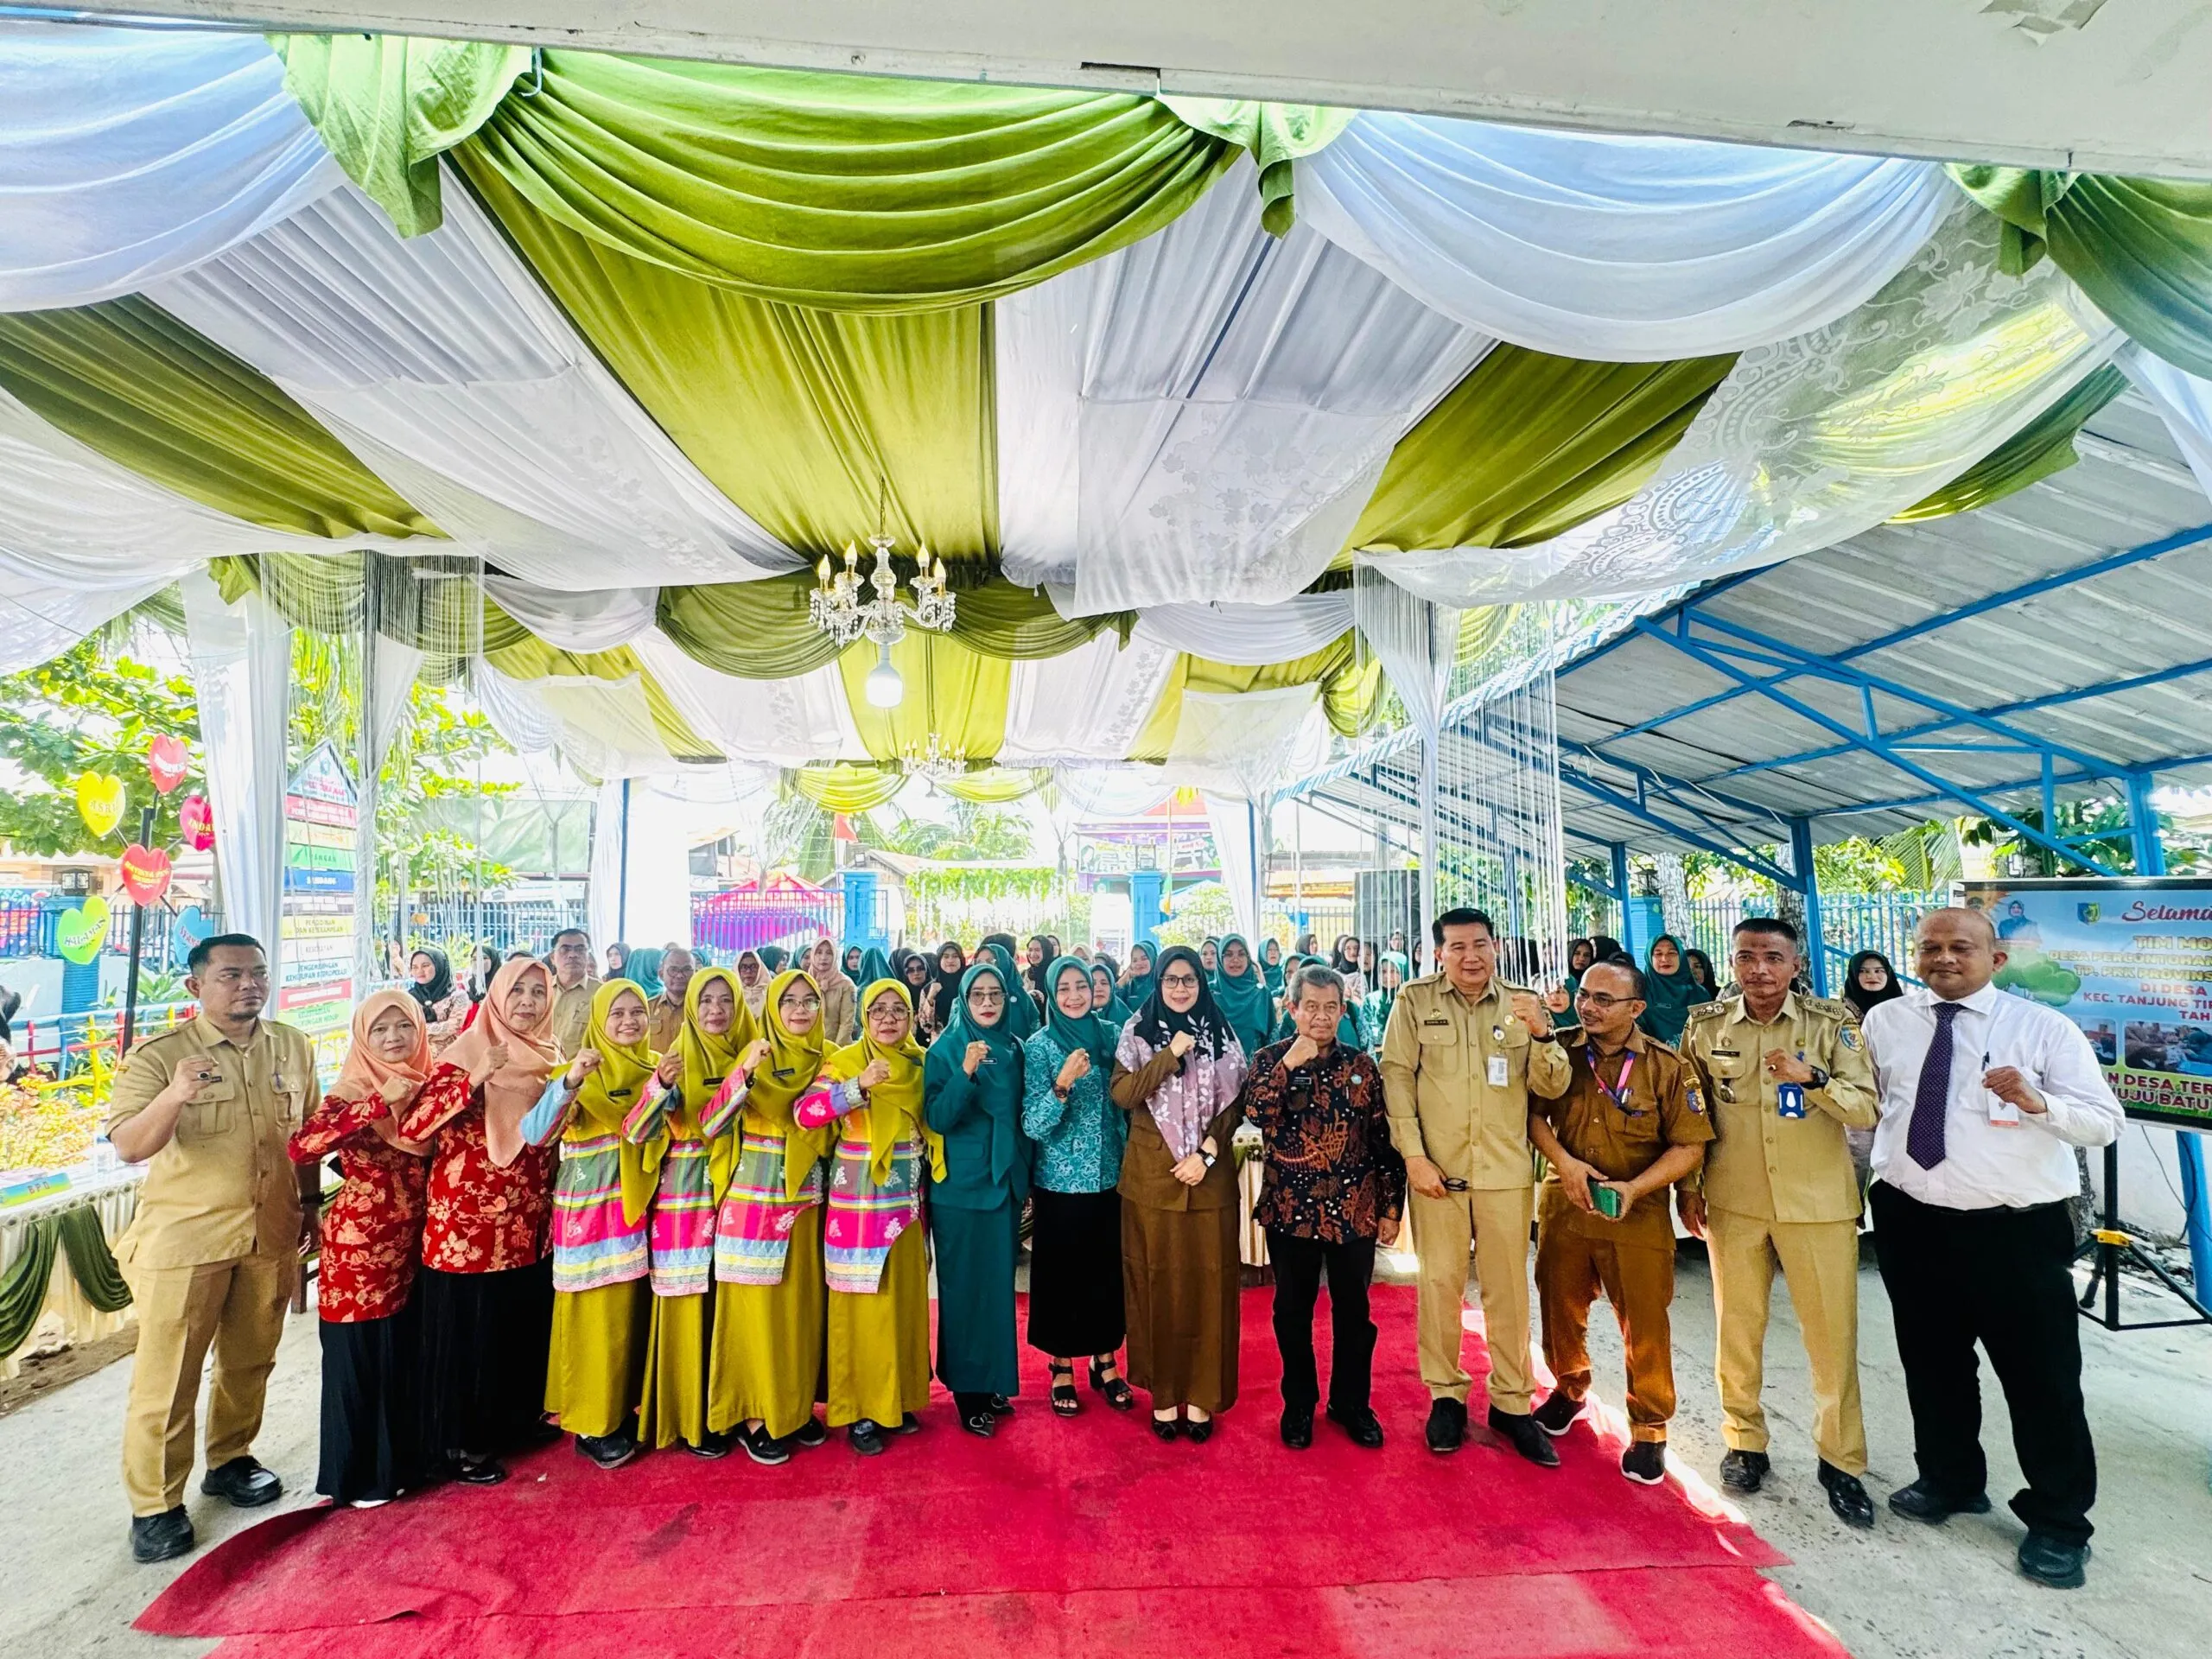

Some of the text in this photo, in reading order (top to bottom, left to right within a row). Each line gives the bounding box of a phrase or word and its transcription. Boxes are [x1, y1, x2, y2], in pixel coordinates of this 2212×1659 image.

[2133, 935, 2212, 950] TIM MO
[2049, 950, 2090, 962] DESA
[2074, 964, 2212, 982] TP. PKK PROVINS
[2140, 982, 2208, 996] DI DESA
[2083, 992, 2114, 1003] KEC.
[2118, 995, 2189, 1007] TANJUNG
[2178, 1010, 2211, 1021] TAH
[2124, 1074, 2174, 1091] DESA
[2179, 1080, 2212, 1095] TER
[2159, 1093, 2210, 1110] BATU
